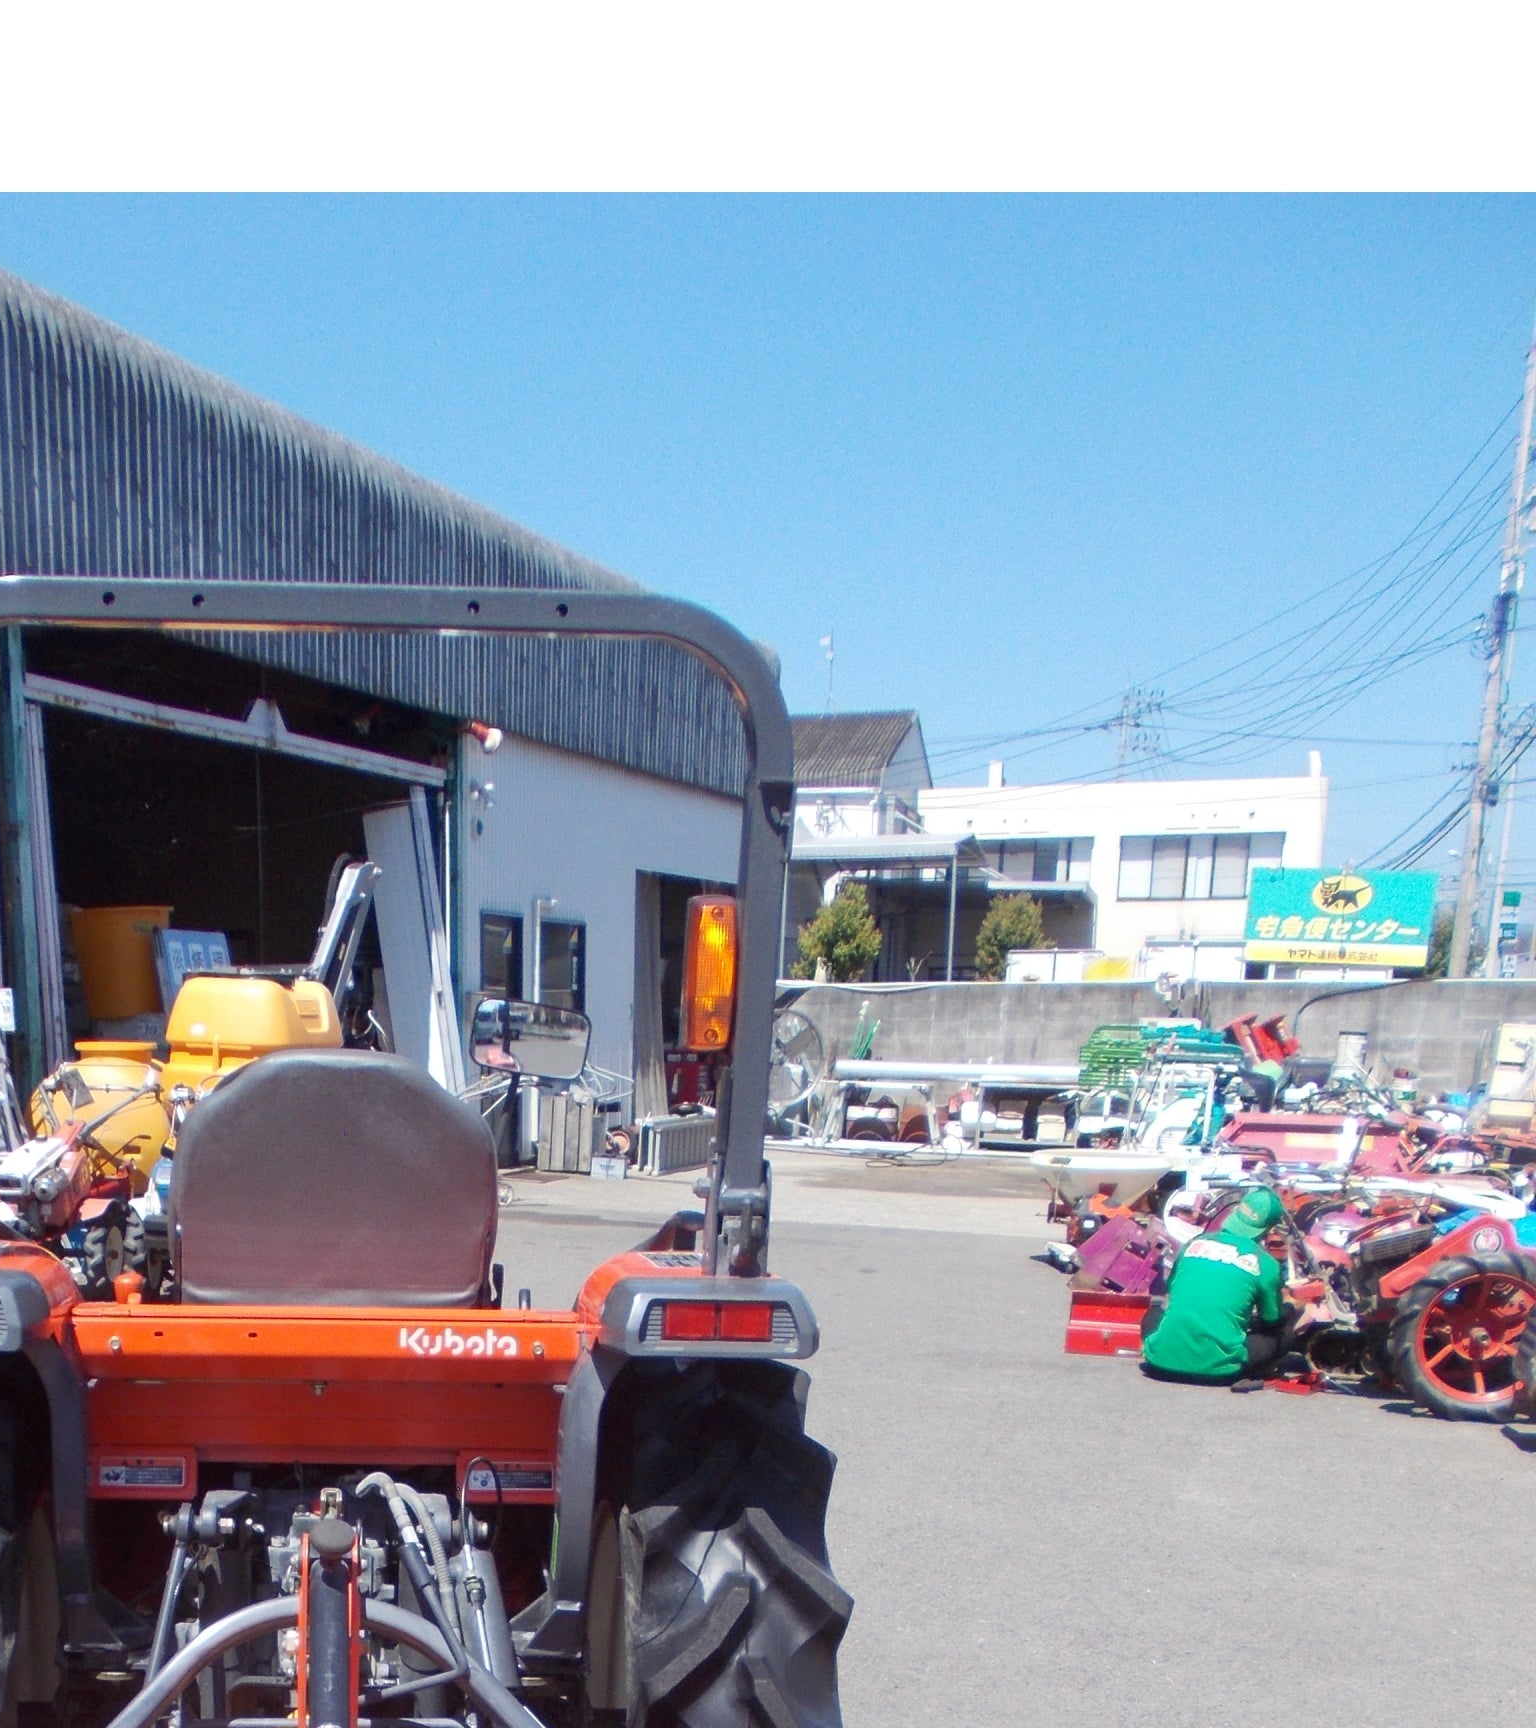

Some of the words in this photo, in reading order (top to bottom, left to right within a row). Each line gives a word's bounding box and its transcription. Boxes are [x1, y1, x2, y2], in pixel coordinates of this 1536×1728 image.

[1254, 915, 1421, 942] 宅急便センター
[1287, 948, 1379, 962] ヤマト運輸式会社
[399, 1327, 518, 1356] Kubota
